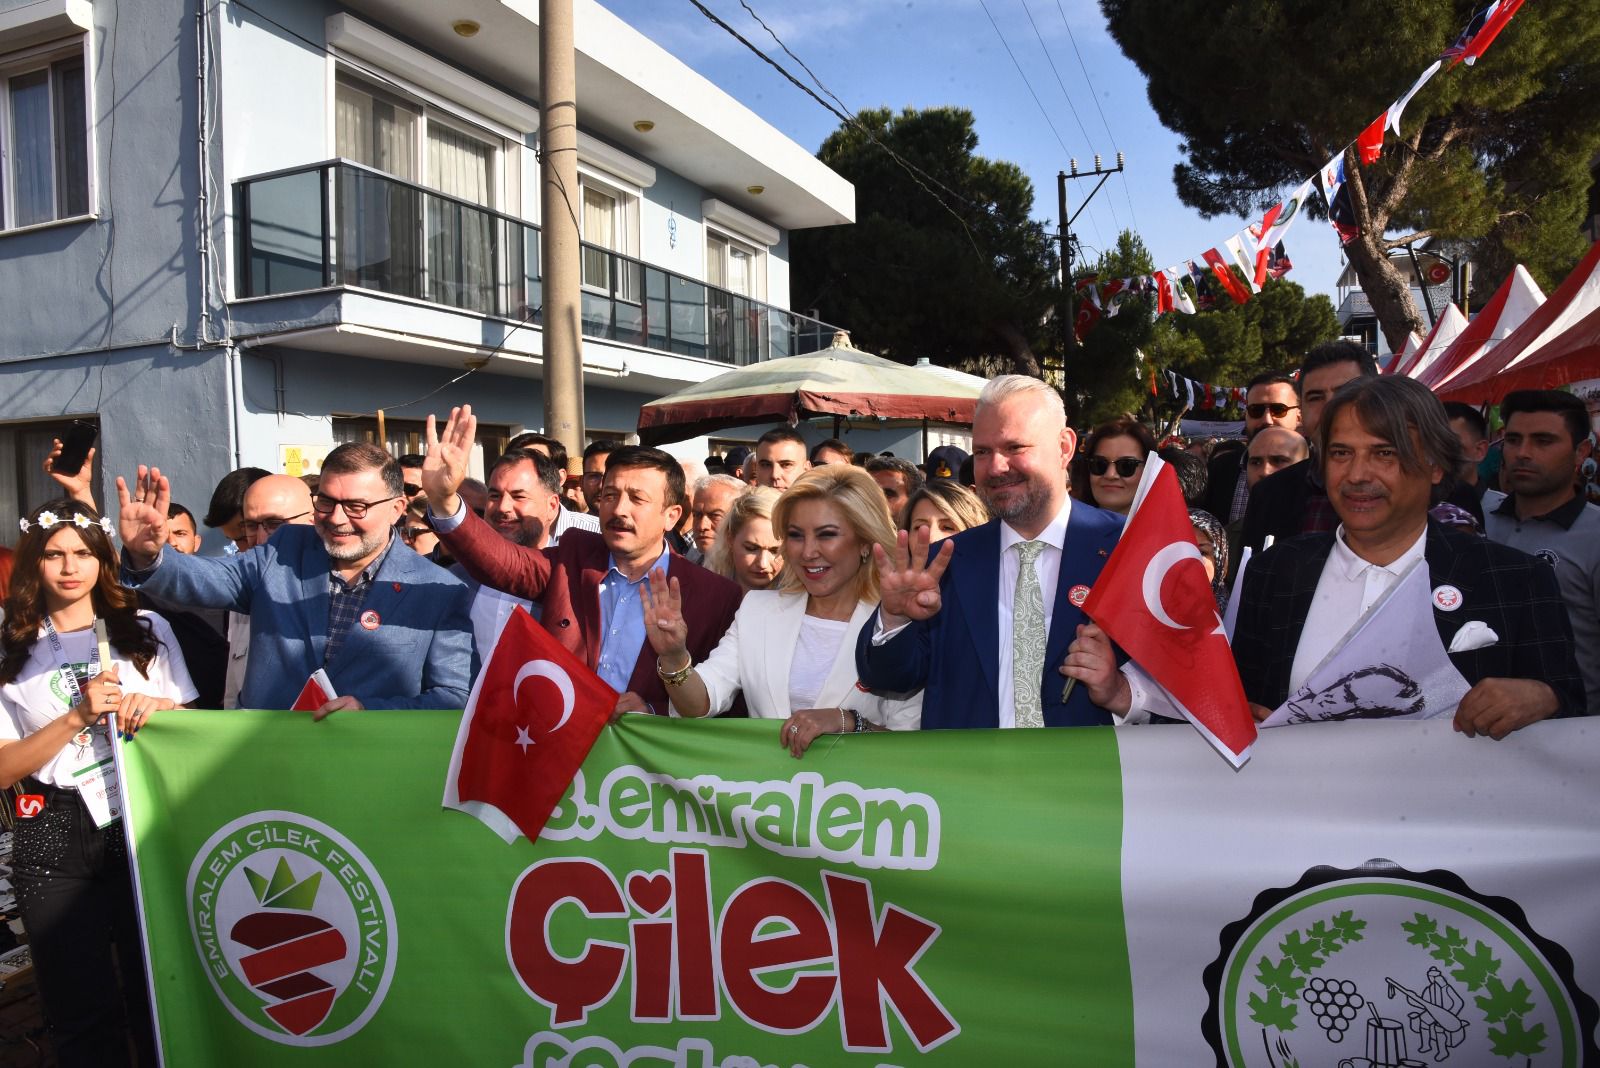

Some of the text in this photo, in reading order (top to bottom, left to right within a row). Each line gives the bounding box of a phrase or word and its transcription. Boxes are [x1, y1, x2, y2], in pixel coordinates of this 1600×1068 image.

[199, 823, 383, 995] EMİRALEM ÇİLEK FESTİVALİ
[507, 850, 959, 1050] Çilek
